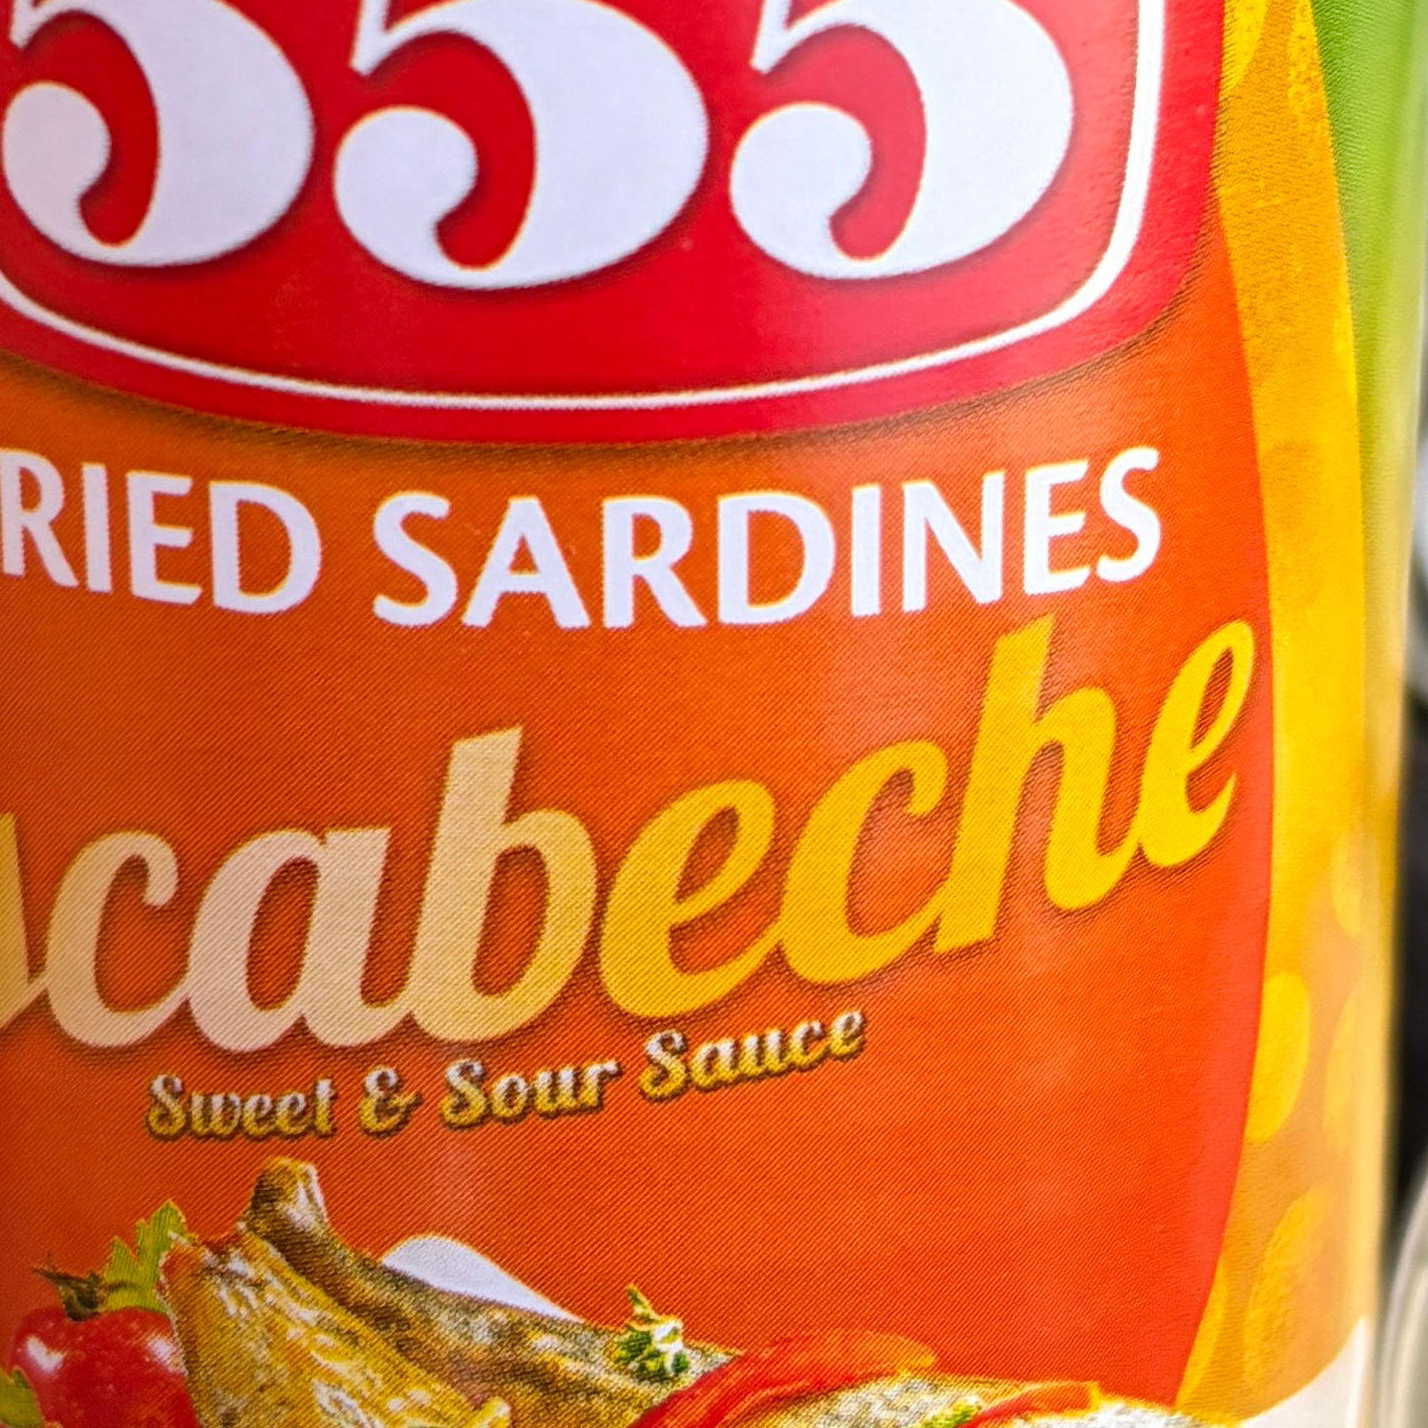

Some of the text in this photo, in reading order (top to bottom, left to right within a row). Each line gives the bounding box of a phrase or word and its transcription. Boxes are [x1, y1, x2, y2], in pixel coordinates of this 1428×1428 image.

[371, 445, 1163, 630] SARDINES
[146, 1003, 868, 1142] Sweet & Sour Sauce
